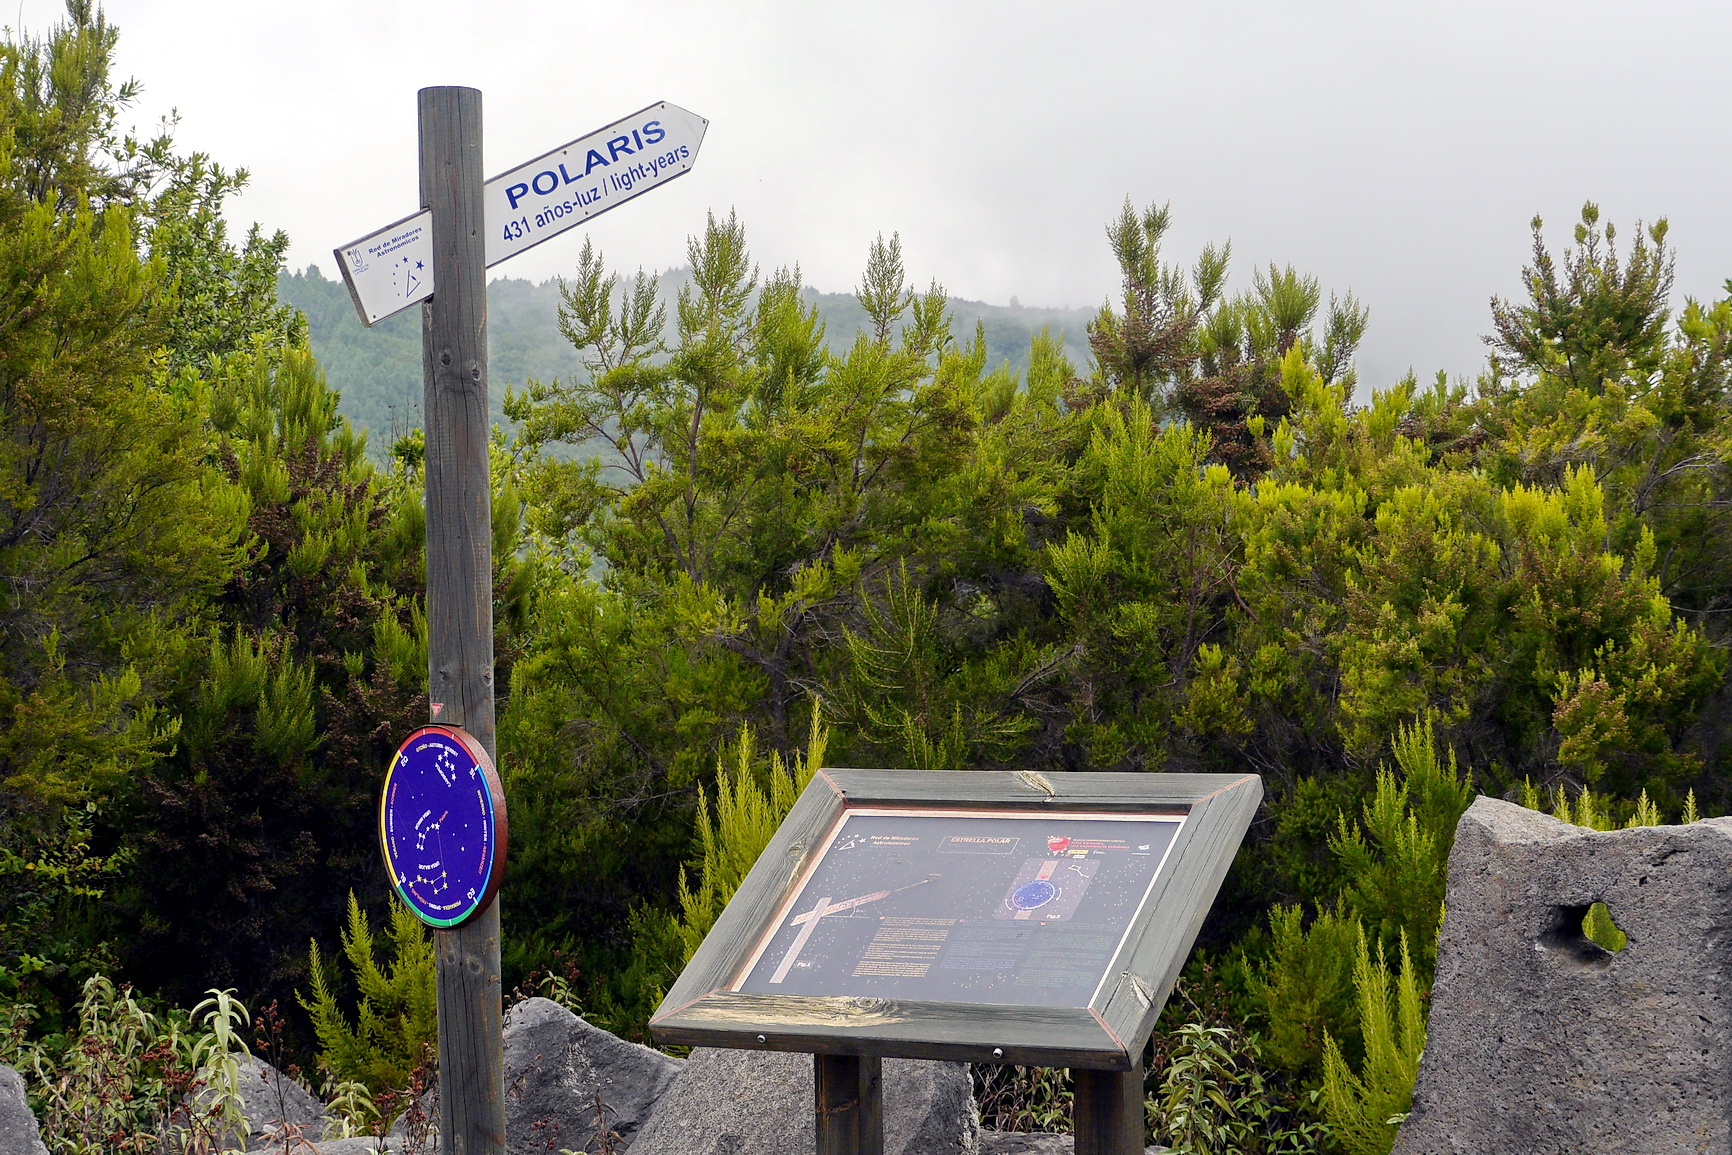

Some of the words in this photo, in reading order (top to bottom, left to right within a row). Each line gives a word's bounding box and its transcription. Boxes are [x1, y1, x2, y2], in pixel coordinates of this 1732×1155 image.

[505, 120, 666, 210] POLARIS
[503, 216, 531, 242] 431
[535, 187, 601, 228] años-luz
[602, 178, 608, 196] /
[610, 145, 690, 192] light-years
[368, 245, 381, 255] Red
[382, 241, 391, 249] de
[391, 227, 422, 244] Miradores
[376, 235, 420, 258] Astronómicos
[400, 755, 409, 768] EQ
[469, 767, 476, 780] SL
[390, 836, 399, 860] VERANO
[400, 871, 407, 884] SL
[466, 887, 476, 900] EQ
